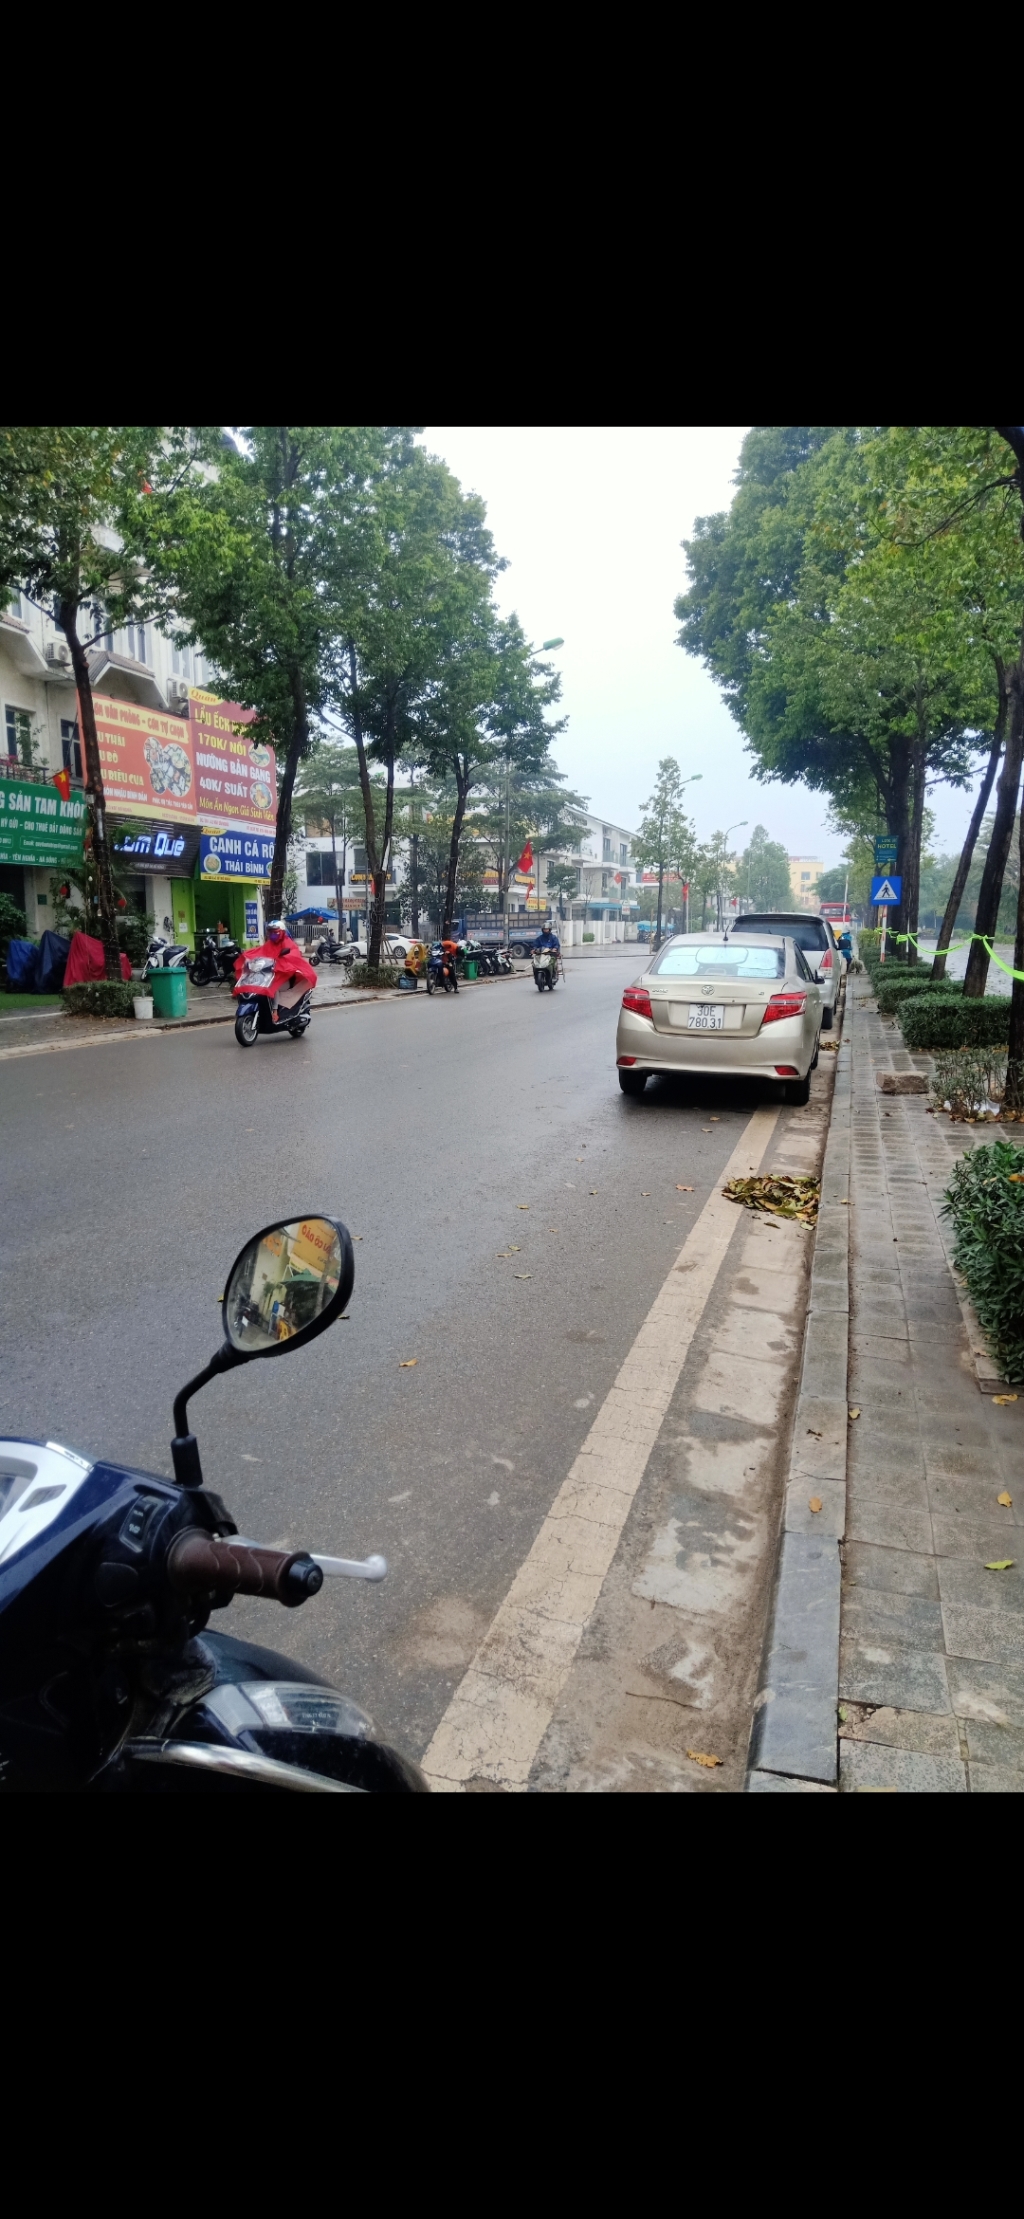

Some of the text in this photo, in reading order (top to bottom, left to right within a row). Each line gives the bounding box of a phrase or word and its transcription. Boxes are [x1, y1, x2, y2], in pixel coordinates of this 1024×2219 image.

[191, 689, 216, 702] Quán
[213, 711, 230, 732] ẾCH
[196, 752, 228, 772] NƯỚNG
[249, 766, 271, 784] GANG
[128, 774, 144, 786] CUA
[224, 782, 248, 798] SUẤT
[9, 790, 31, 812] SẢN
[35, 797, 57, 816] TAM
[199, 796, 213, 809] Món
[224, 801, 239, 815] Ngon
[240, 805, 249, 816] Giá
[250, 806, 262, 819] Sinh
[263, 810, 274, 821] Viên
[24, 820, 35, 831] CHO
[36, 821, 48, 832] THUÊ
[154, 832, 185, 856] Quê
[209, 836, 274, 859] CANH CÁ RÔ
[225, 859, 264, 874] THÁI BÌNH
[697, 1005, 716, 1017] 30E
[688, 1017, 721, 1029] 780.31
